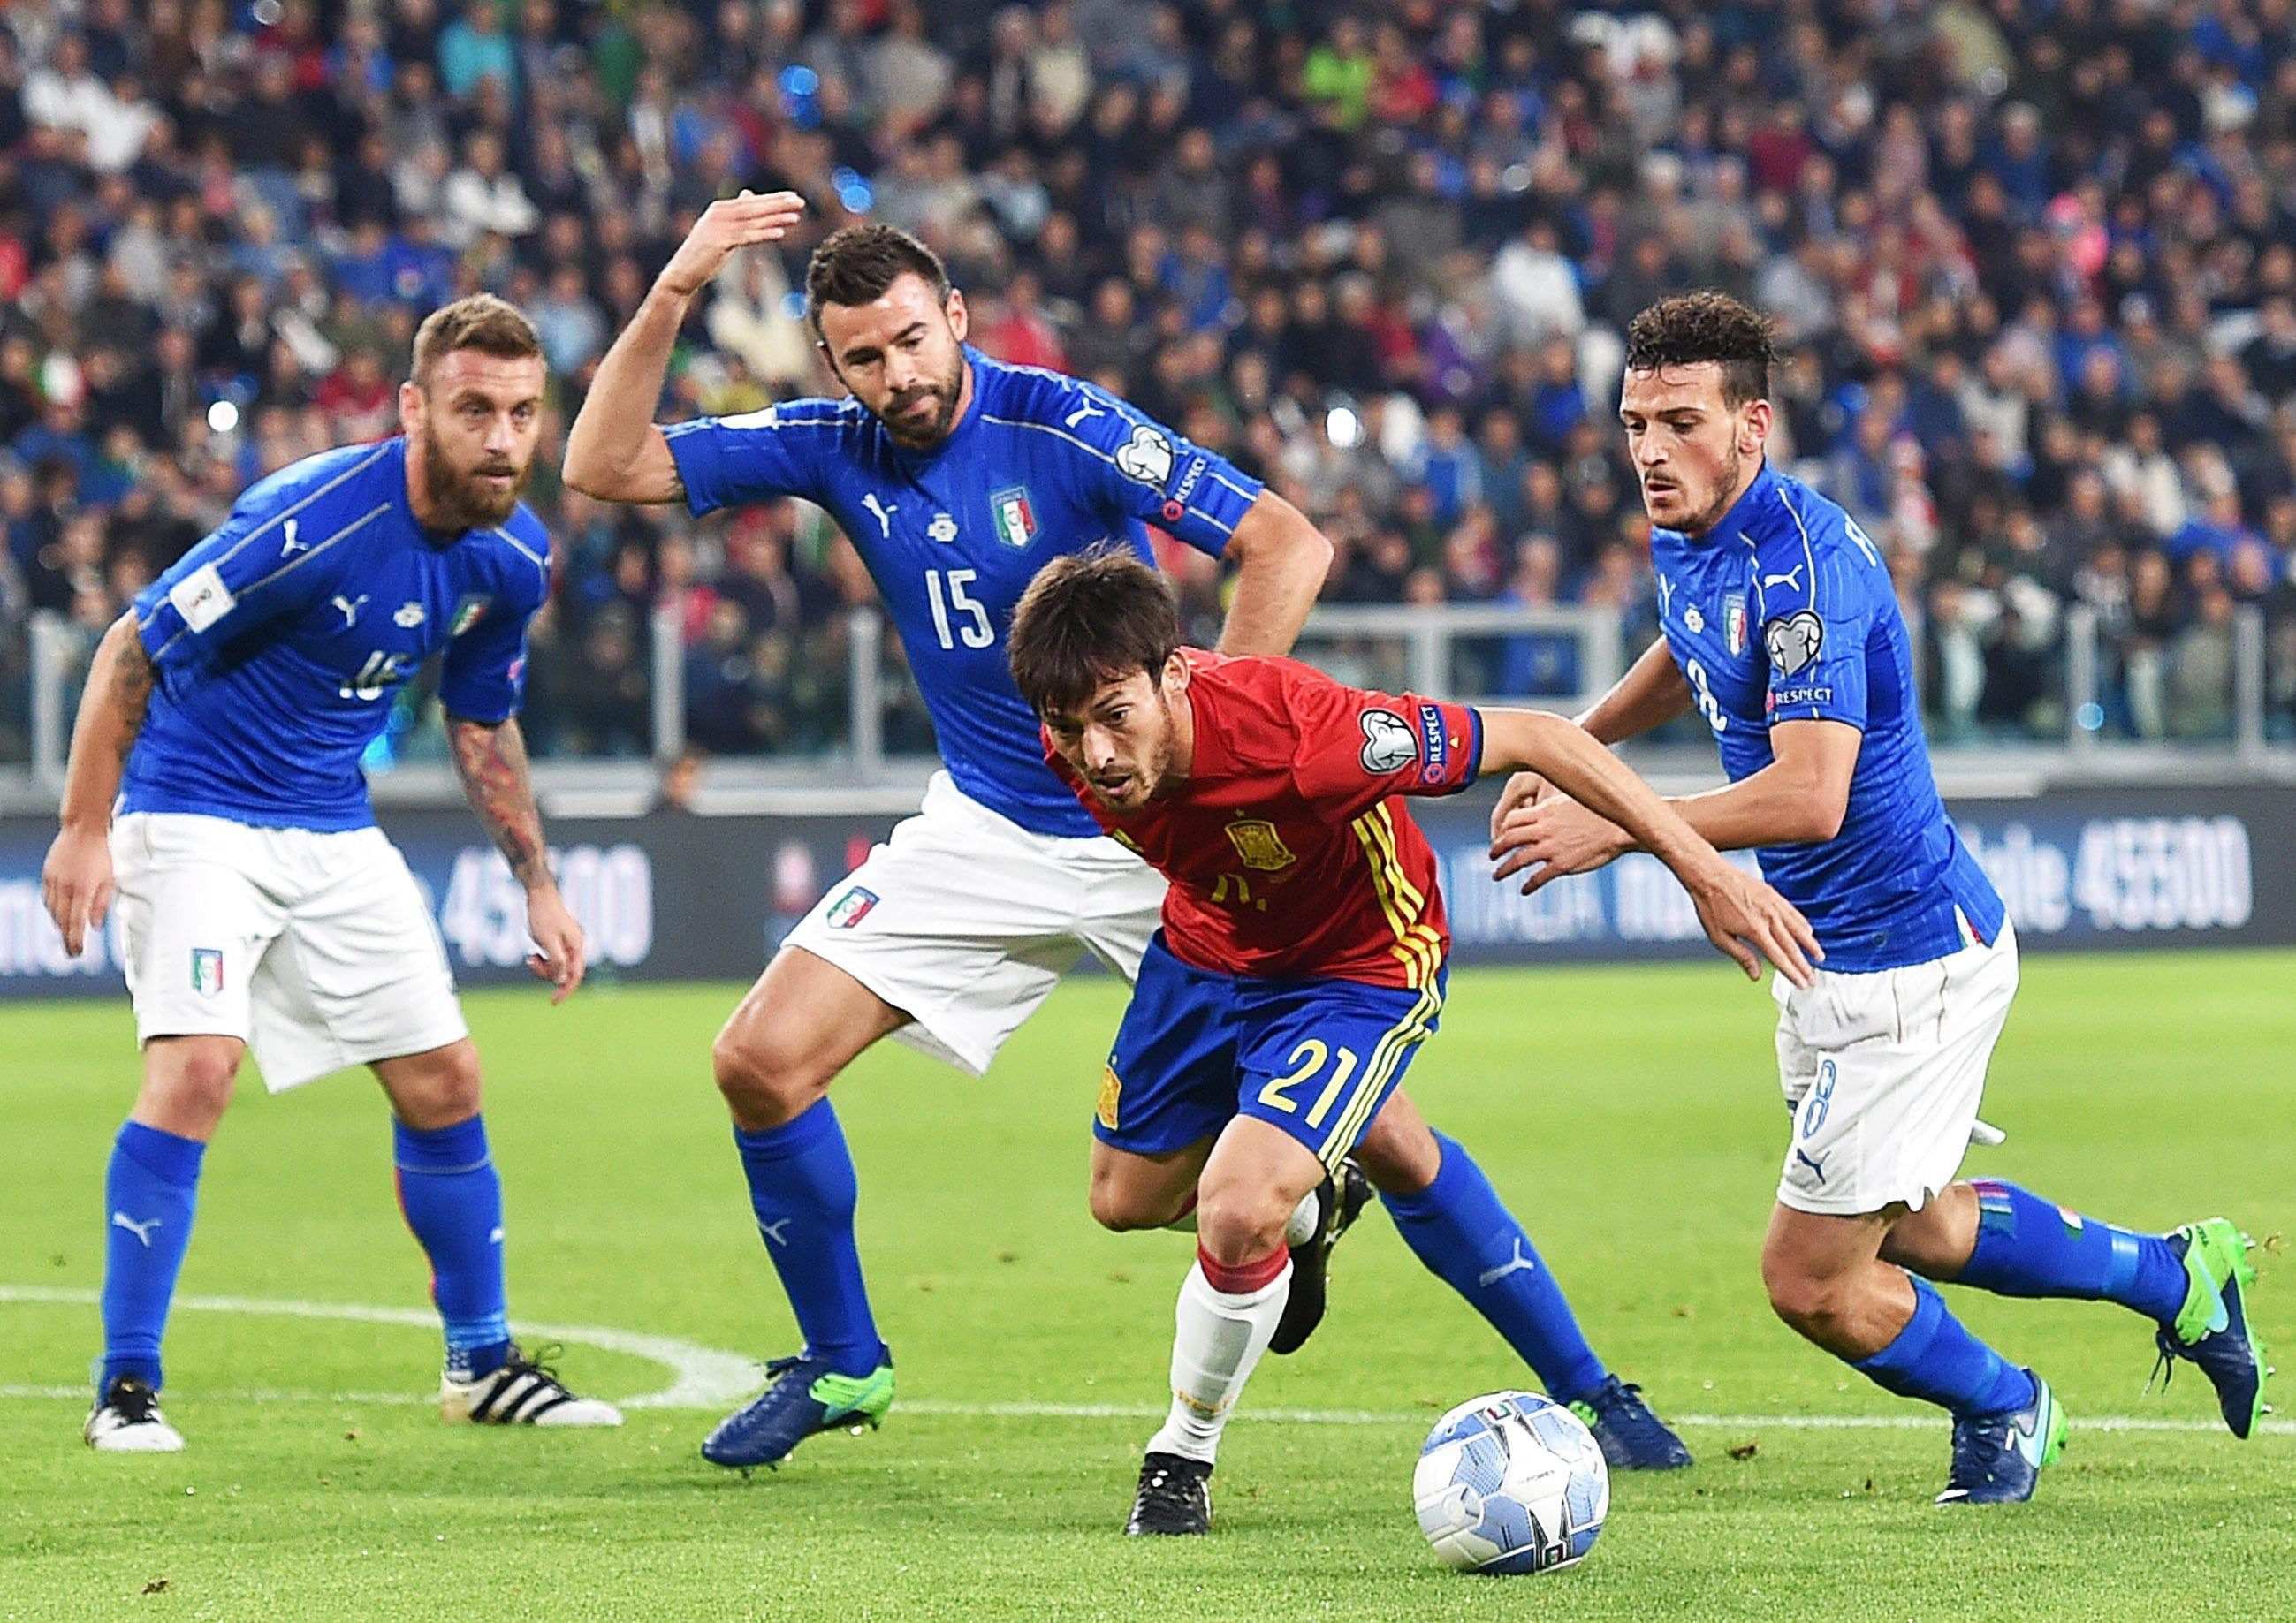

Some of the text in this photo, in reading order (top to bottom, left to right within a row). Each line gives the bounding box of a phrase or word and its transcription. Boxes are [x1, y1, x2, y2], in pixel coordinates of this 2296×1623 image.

[925, 568, 997, 650] 15
[1420, 706, 1443, 762] RESPECT
[1775, 686, 1832, 705] RESPECT
[441, 845, 654, 967] 4500
[1258, 1038, 1358, 1130] 21
[1802, 1058, 1836, 1140] 8
